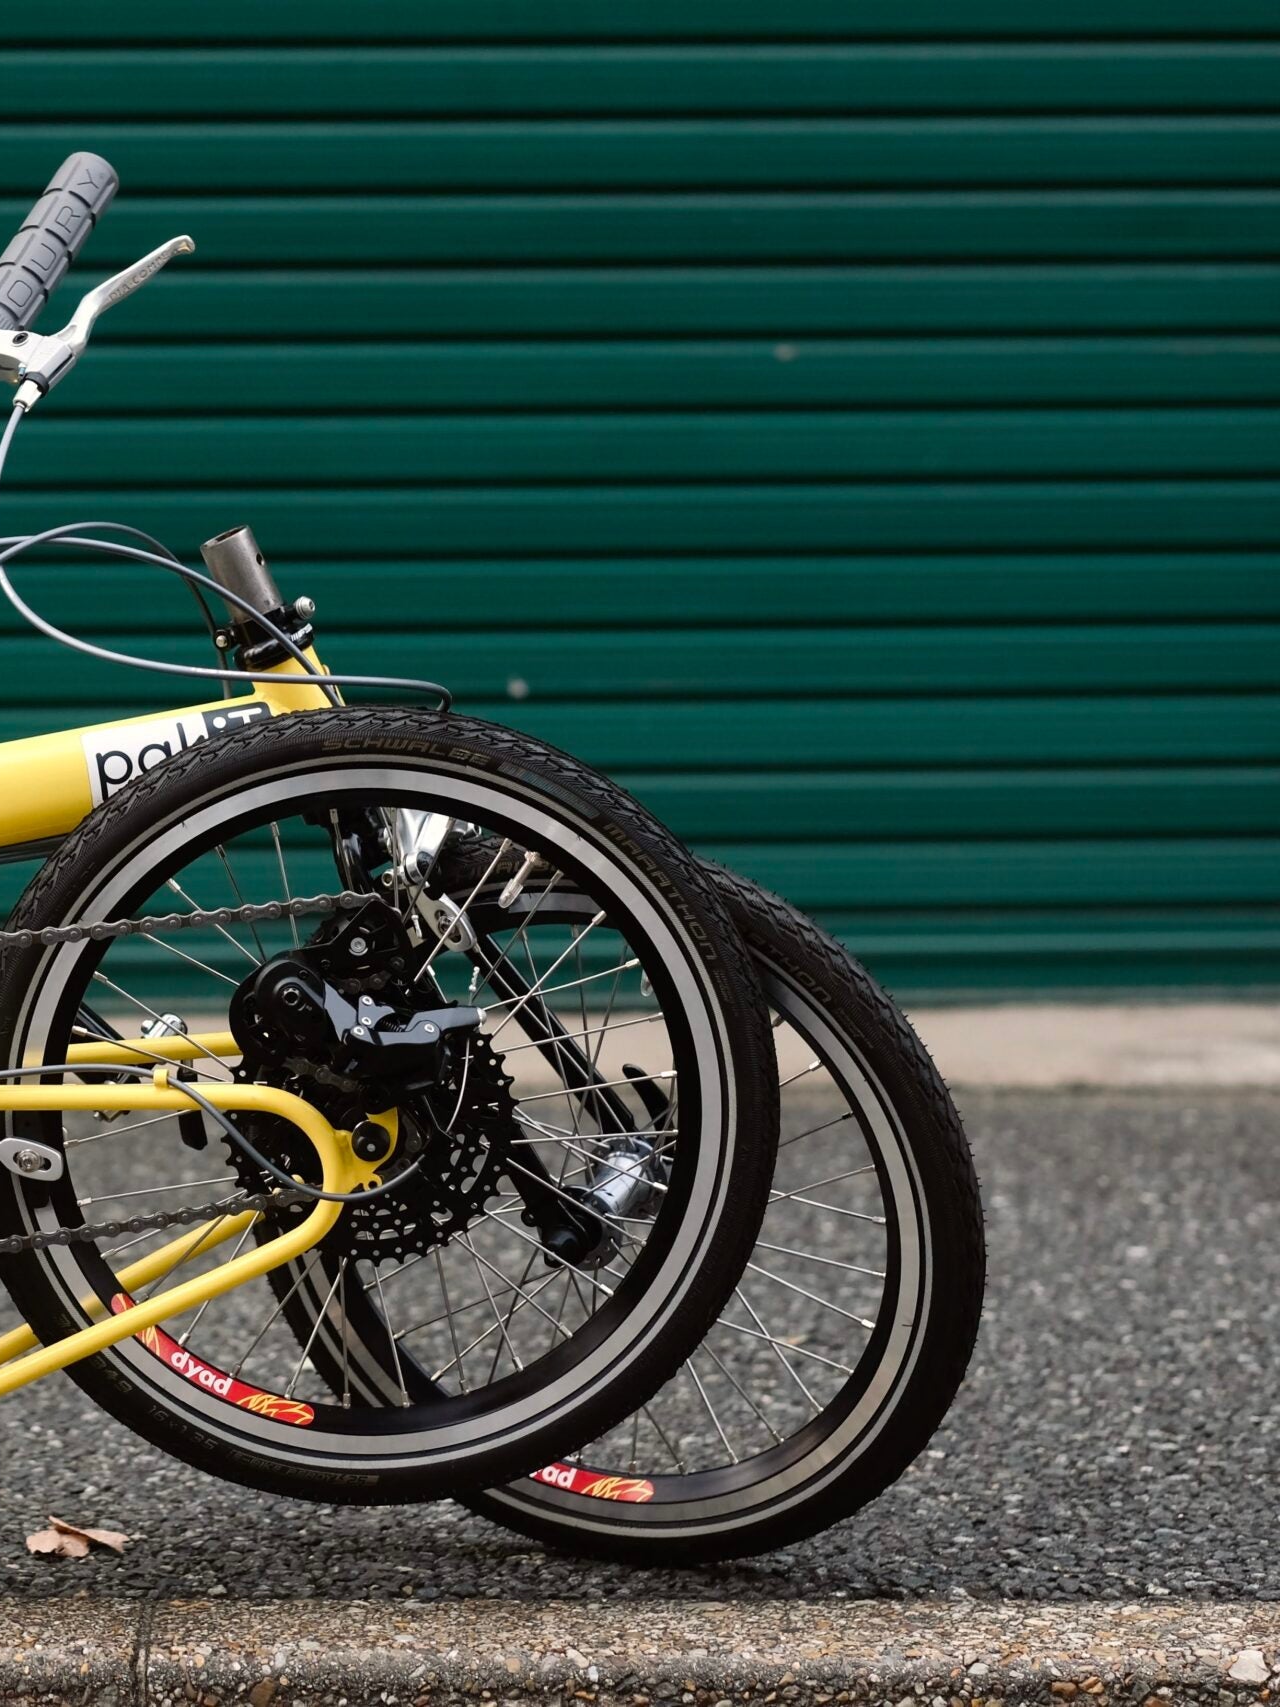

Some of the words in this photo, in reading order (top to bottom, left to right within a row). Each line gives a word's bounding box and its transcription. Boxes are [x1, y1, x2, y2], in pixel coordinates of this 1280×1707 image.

[7, 168, 100, 308] OURY
[321, 736, 492, 767] SCHWALBE
[603, 820, 718, 961] MARATHON
[170, 1350, 234, 1396] dyad
